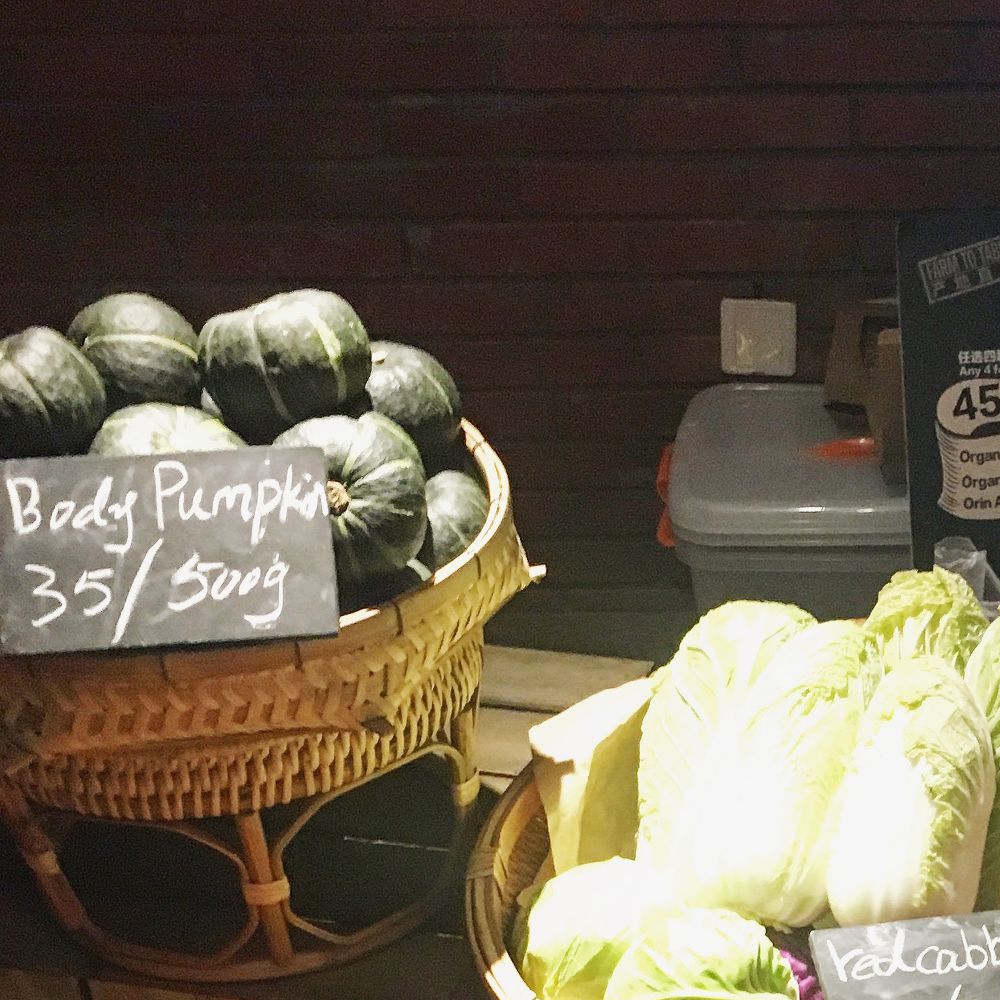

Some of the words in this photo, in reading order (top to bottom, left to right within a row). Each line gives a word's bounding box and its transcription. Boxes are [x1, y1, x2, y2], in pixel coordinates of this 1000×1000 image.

[925, 254, 961, 280] FARM
[961, 250, 978, 269] TO
[960, 367, 981, 377] Any
[983, 364, 991, 374] 4
[963, 497, 992, 509] Orin
[6, 476, 138, 554] Body
